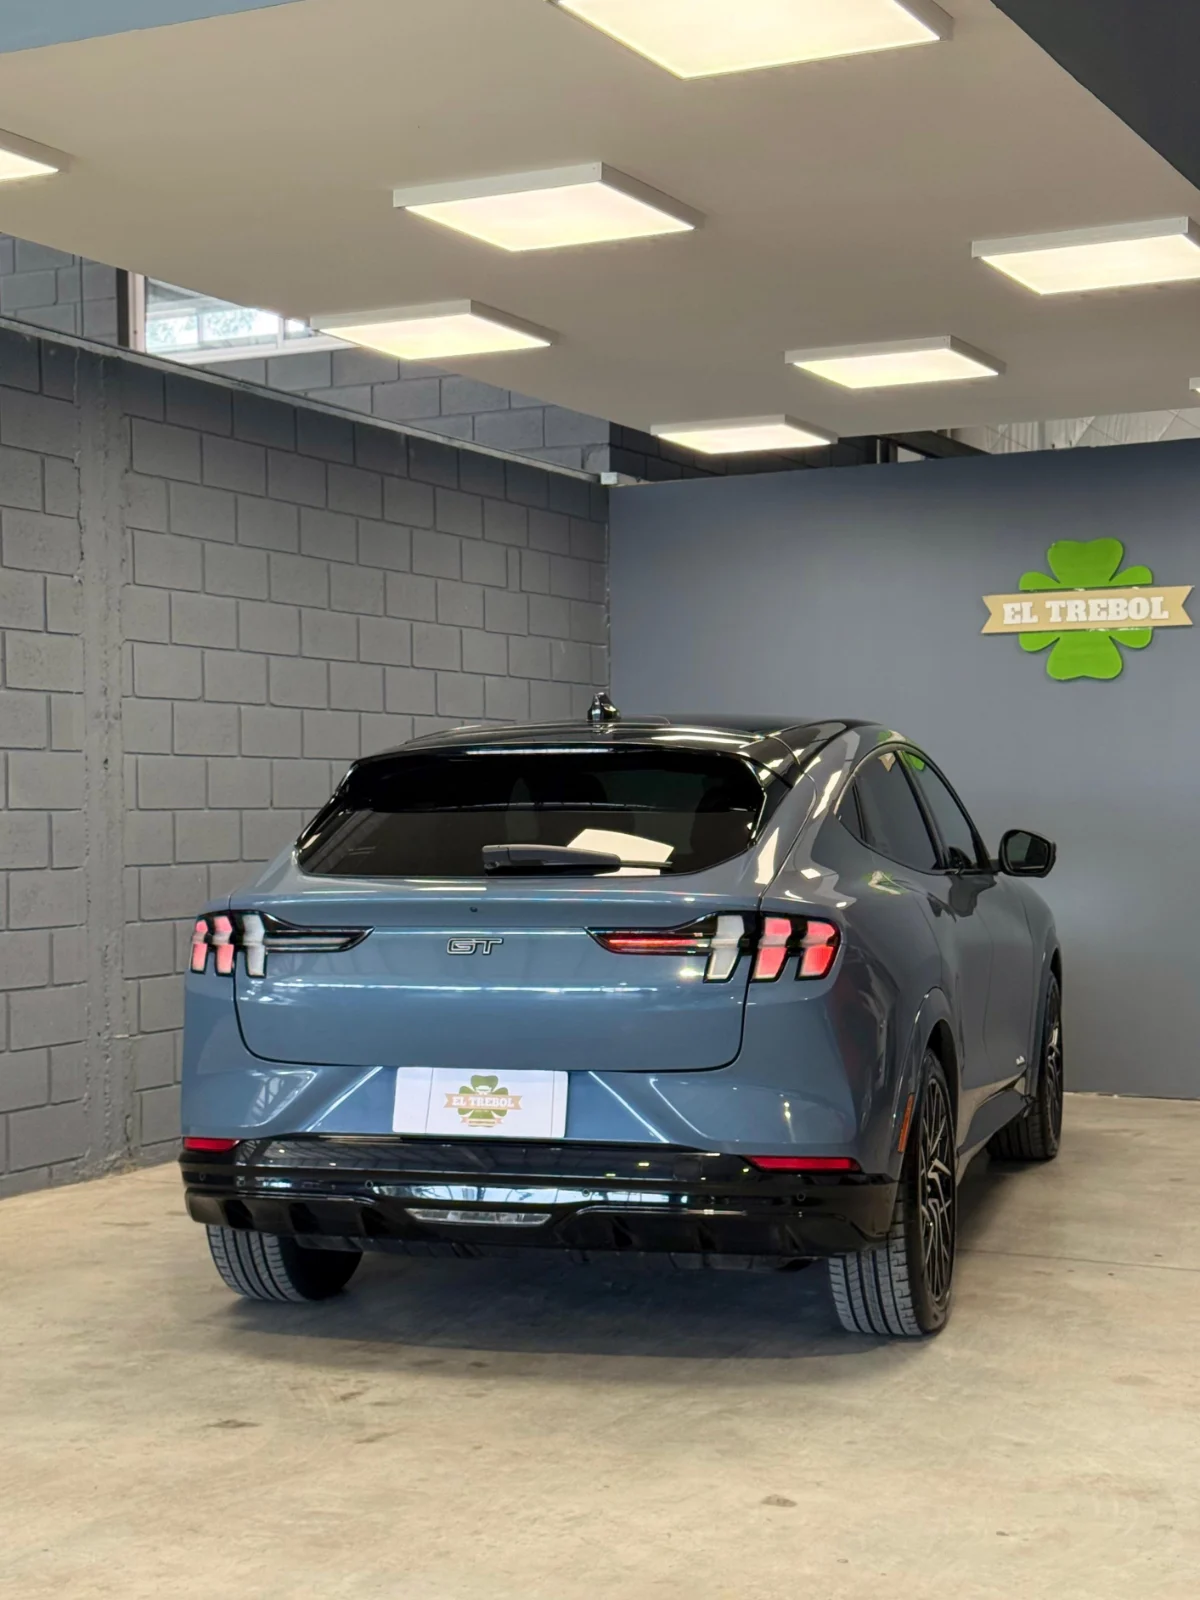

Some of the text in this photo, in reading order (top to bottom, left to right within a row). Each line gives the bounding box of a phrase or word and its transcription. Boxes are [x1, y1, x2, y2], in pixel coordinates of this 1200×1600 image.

[1003, 596, 1169, 624] EL TREBOL
[446, 937, 504, 955] GT
[452, 1096, 515, 1107] EL TREBOL
